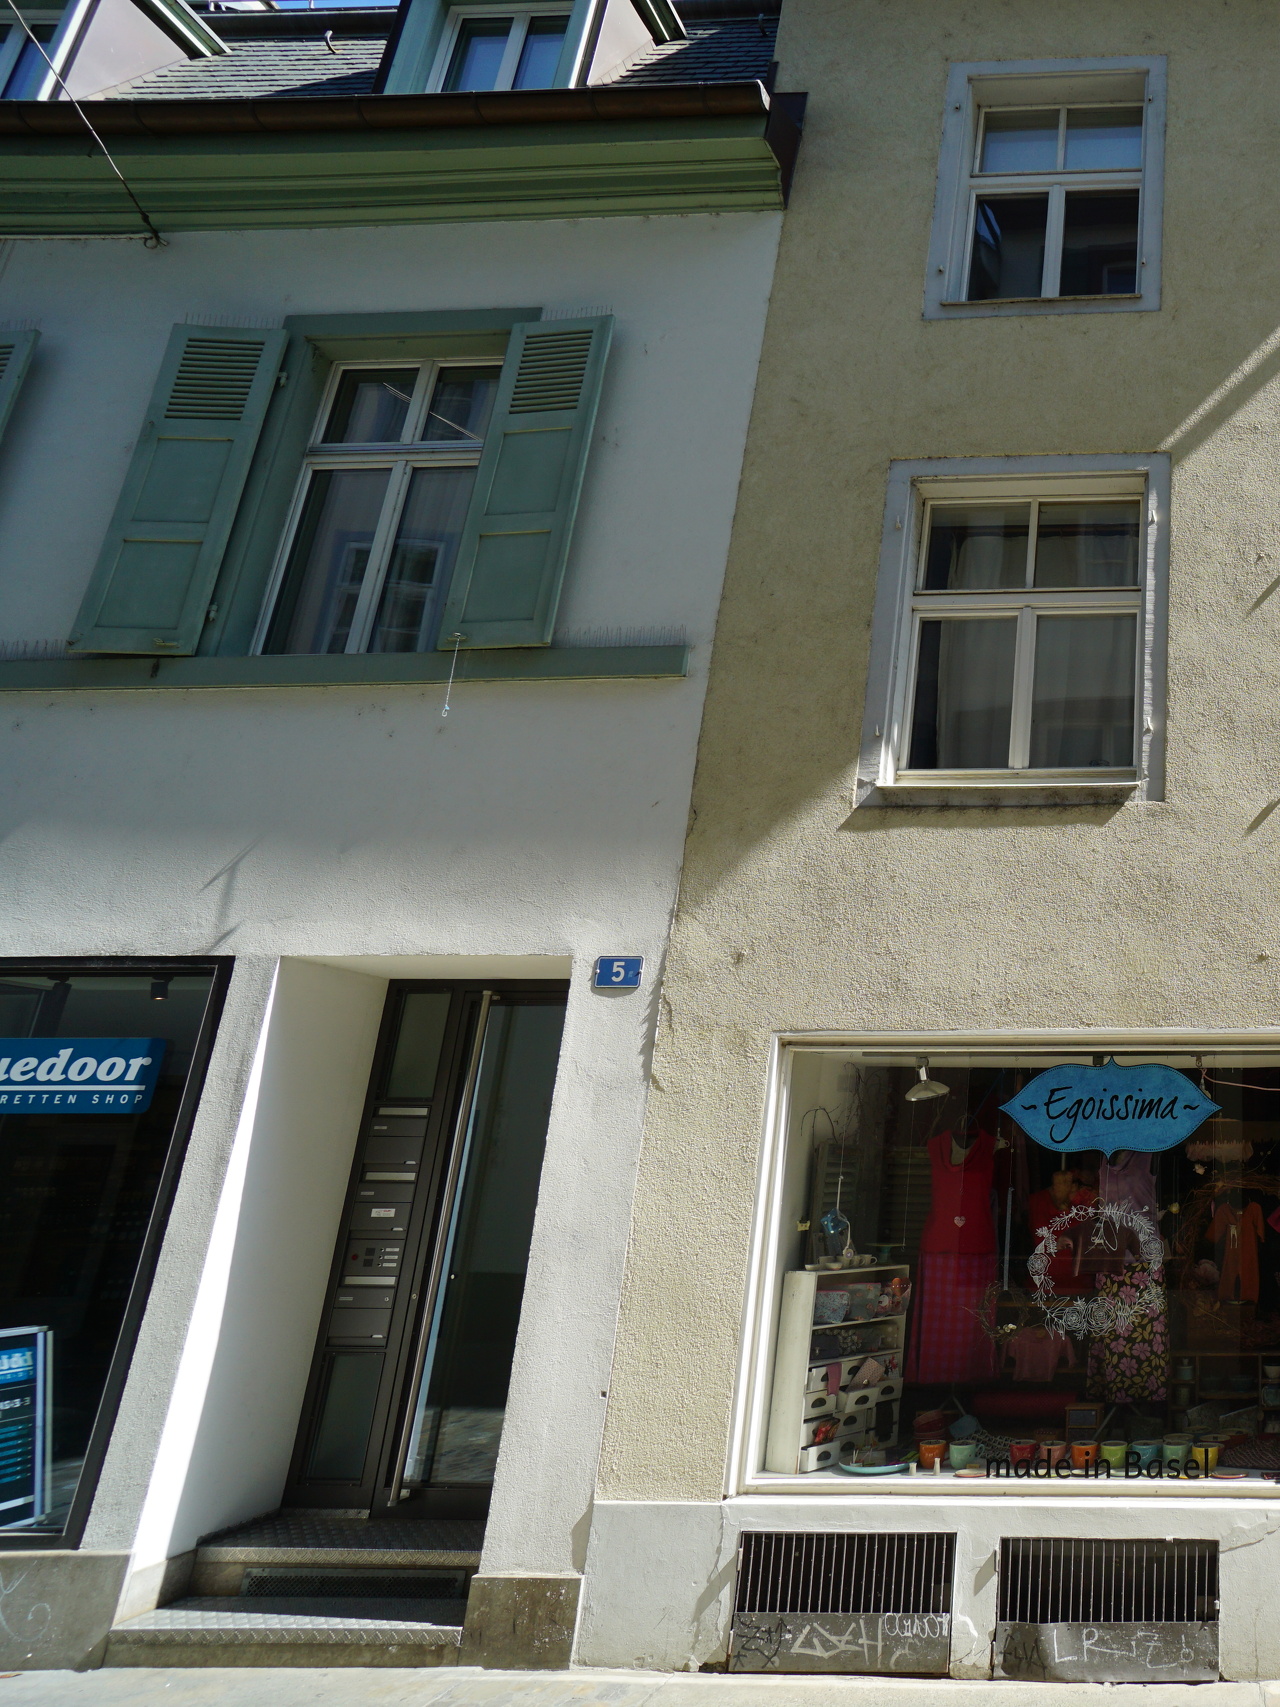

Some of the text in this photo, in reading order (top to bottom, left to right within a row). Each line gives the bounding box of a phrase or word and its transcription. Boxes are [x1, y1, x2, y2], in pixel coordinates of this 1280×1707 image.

[611, 961, 626, 983] 5
[91, 1094, 143, 1104] SHOP
[1043, 1086, 1179, 1144] Egoissima
[985, 1448, 1209, 1480] made in Basel
